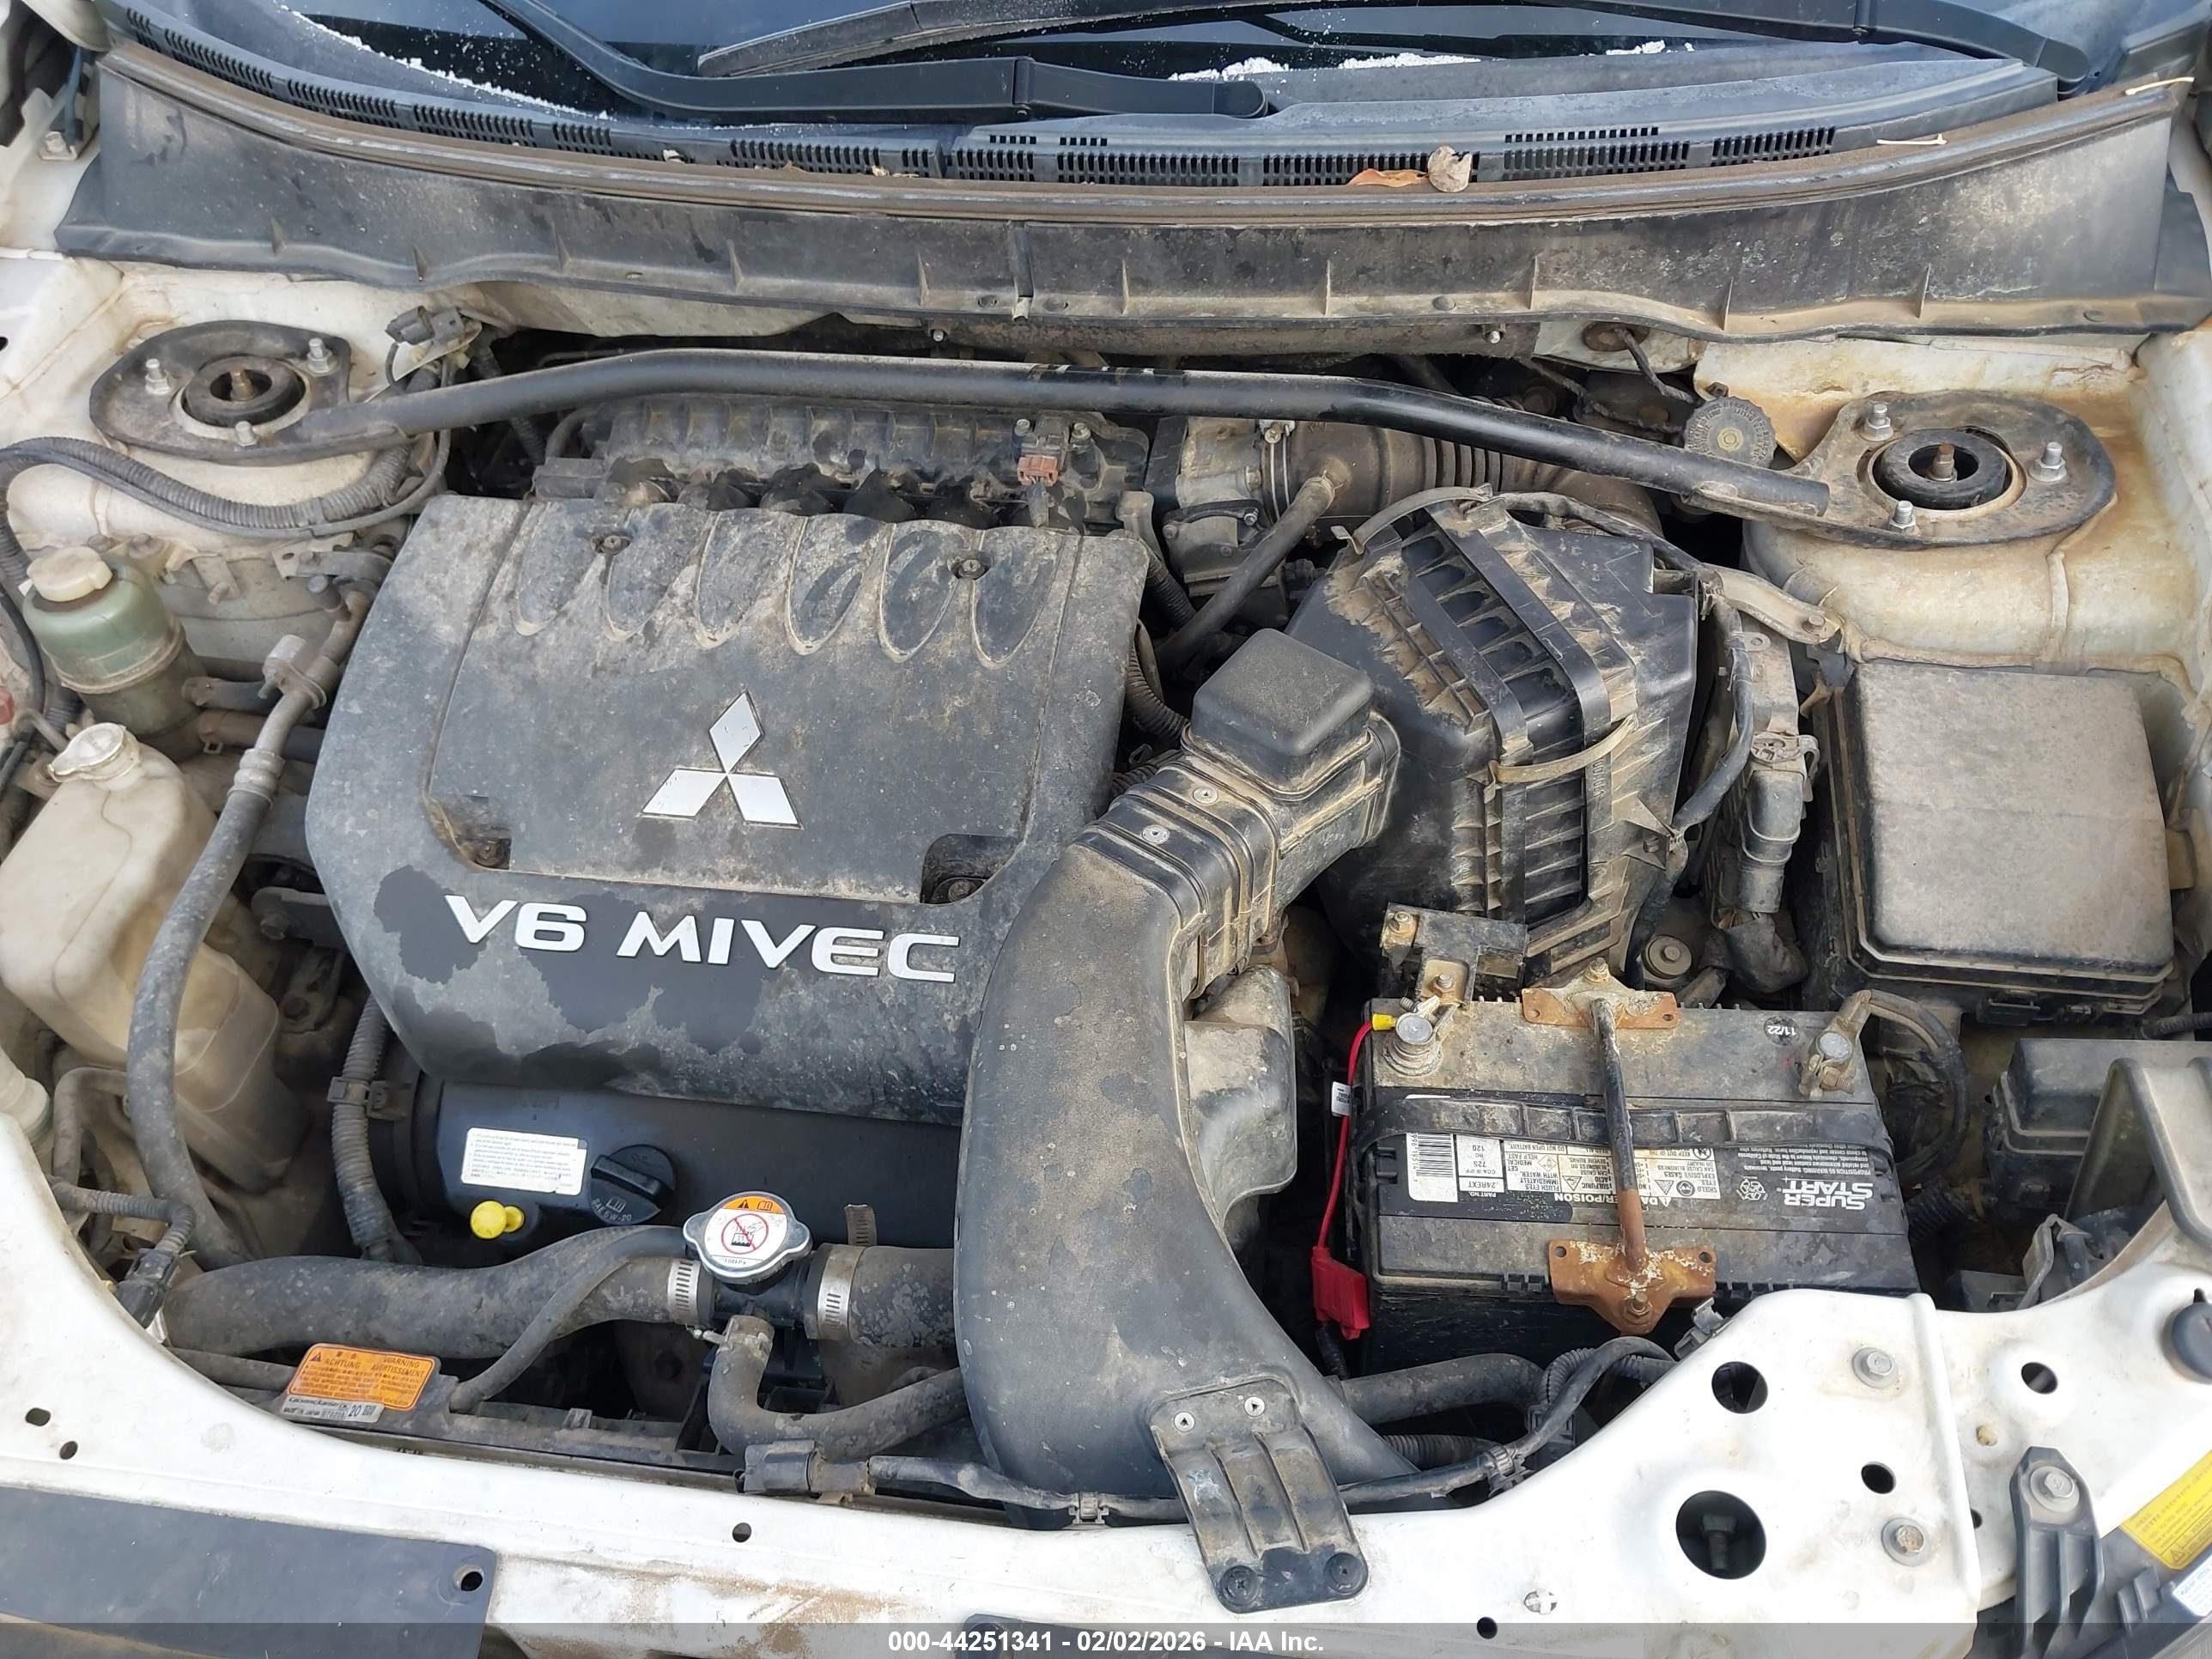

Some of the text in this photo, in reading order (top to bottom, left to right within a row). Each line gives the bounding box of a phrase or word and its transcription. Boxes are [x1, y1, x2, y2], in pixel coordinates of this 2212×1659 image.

[444, 894, 961, 983] V6 MIVEC
[1767, 1025, 1797, 1036] 11/22
[1783, 1181, 1873, 1198] START
[1784, 1194, 1865, 1210] SUPER
[325, 1358, 420, 1369] ACHTUNG WARNING
